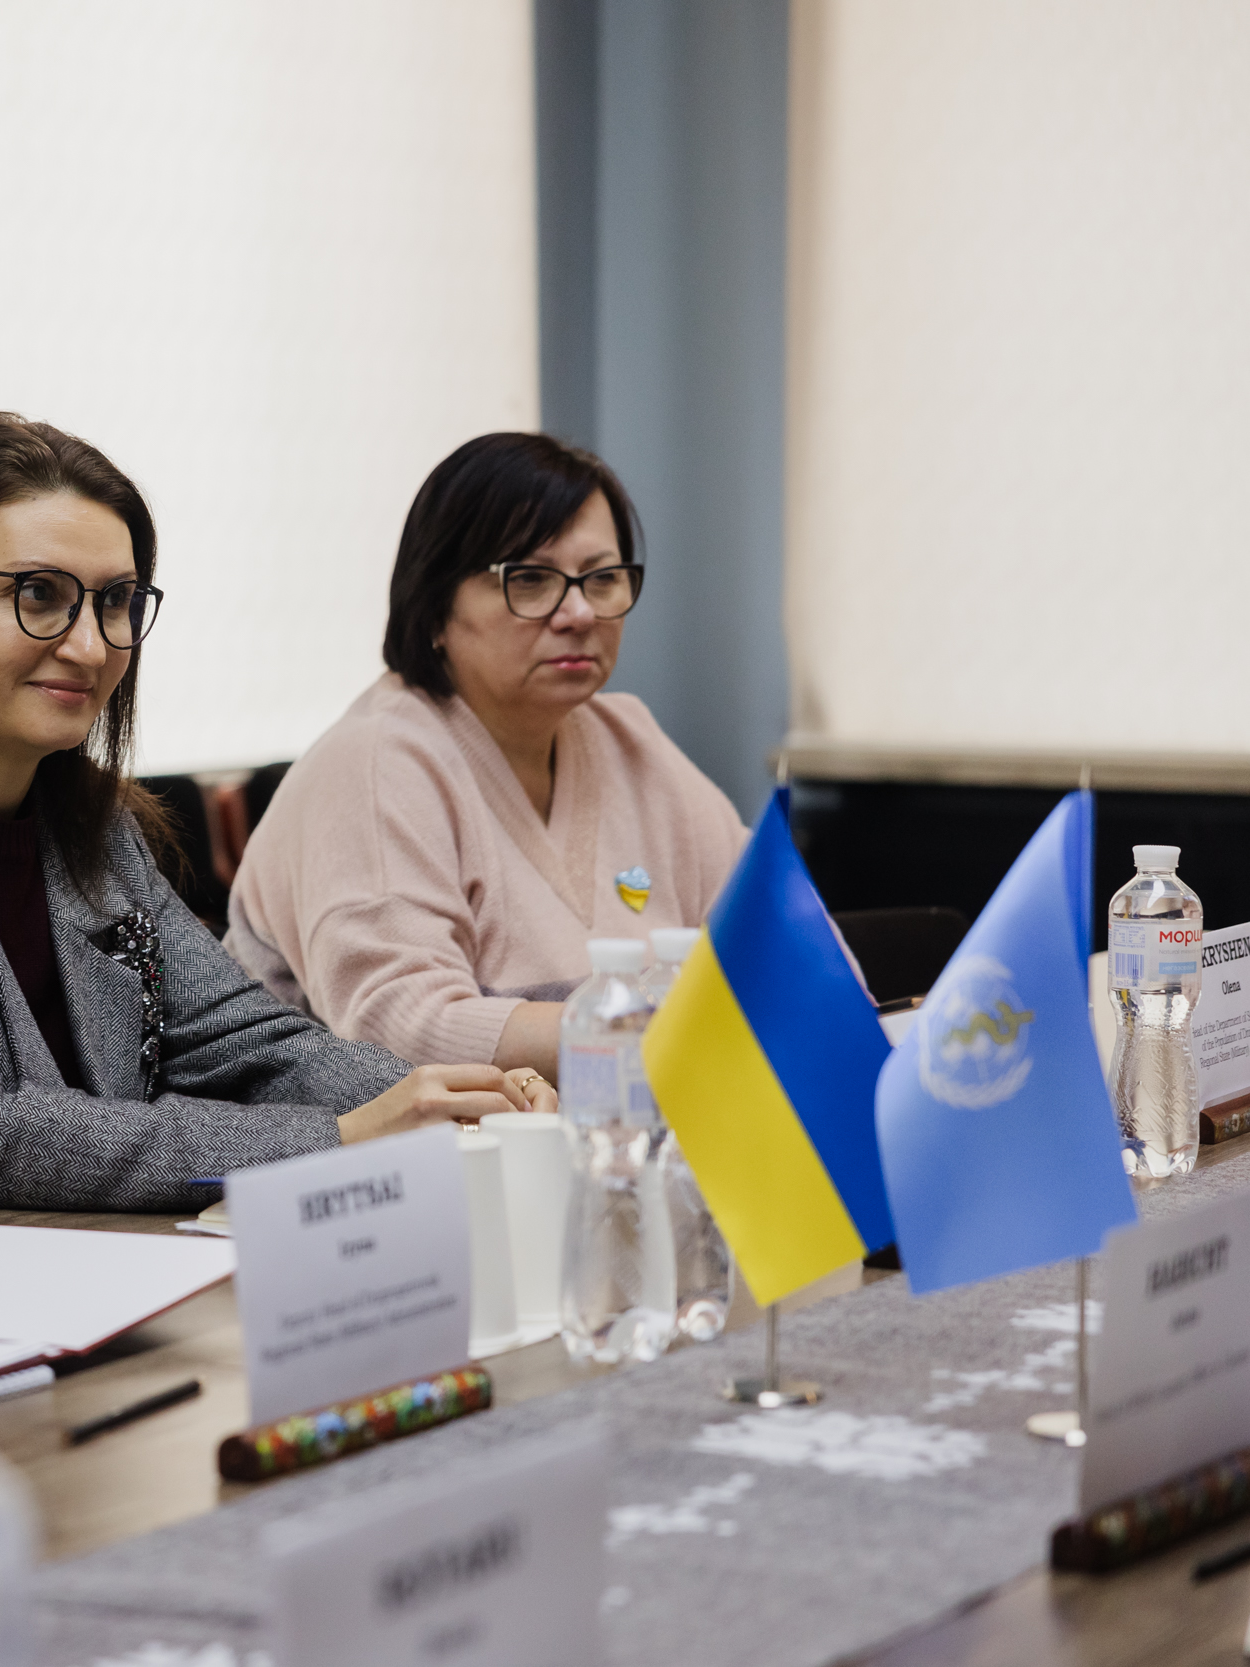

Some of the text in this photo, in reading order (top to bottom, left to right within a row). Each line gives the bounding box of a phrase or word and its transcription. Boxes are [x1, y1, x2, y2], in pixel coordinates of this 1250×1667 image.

[1222, 980, 1241, 995] Olena
[1203, 1022, 1208, 1036] of
[1208, 1021, 1216, 1034] the
[1216, 1015, 1242, 1033] Department
[1202, 1039, 1207, 1052] of
[1214, 1033, 1237, 1049] Population
[1200, 1053, 1219, 1070] Regional
[1219, 1050, 1230, 1063] State
